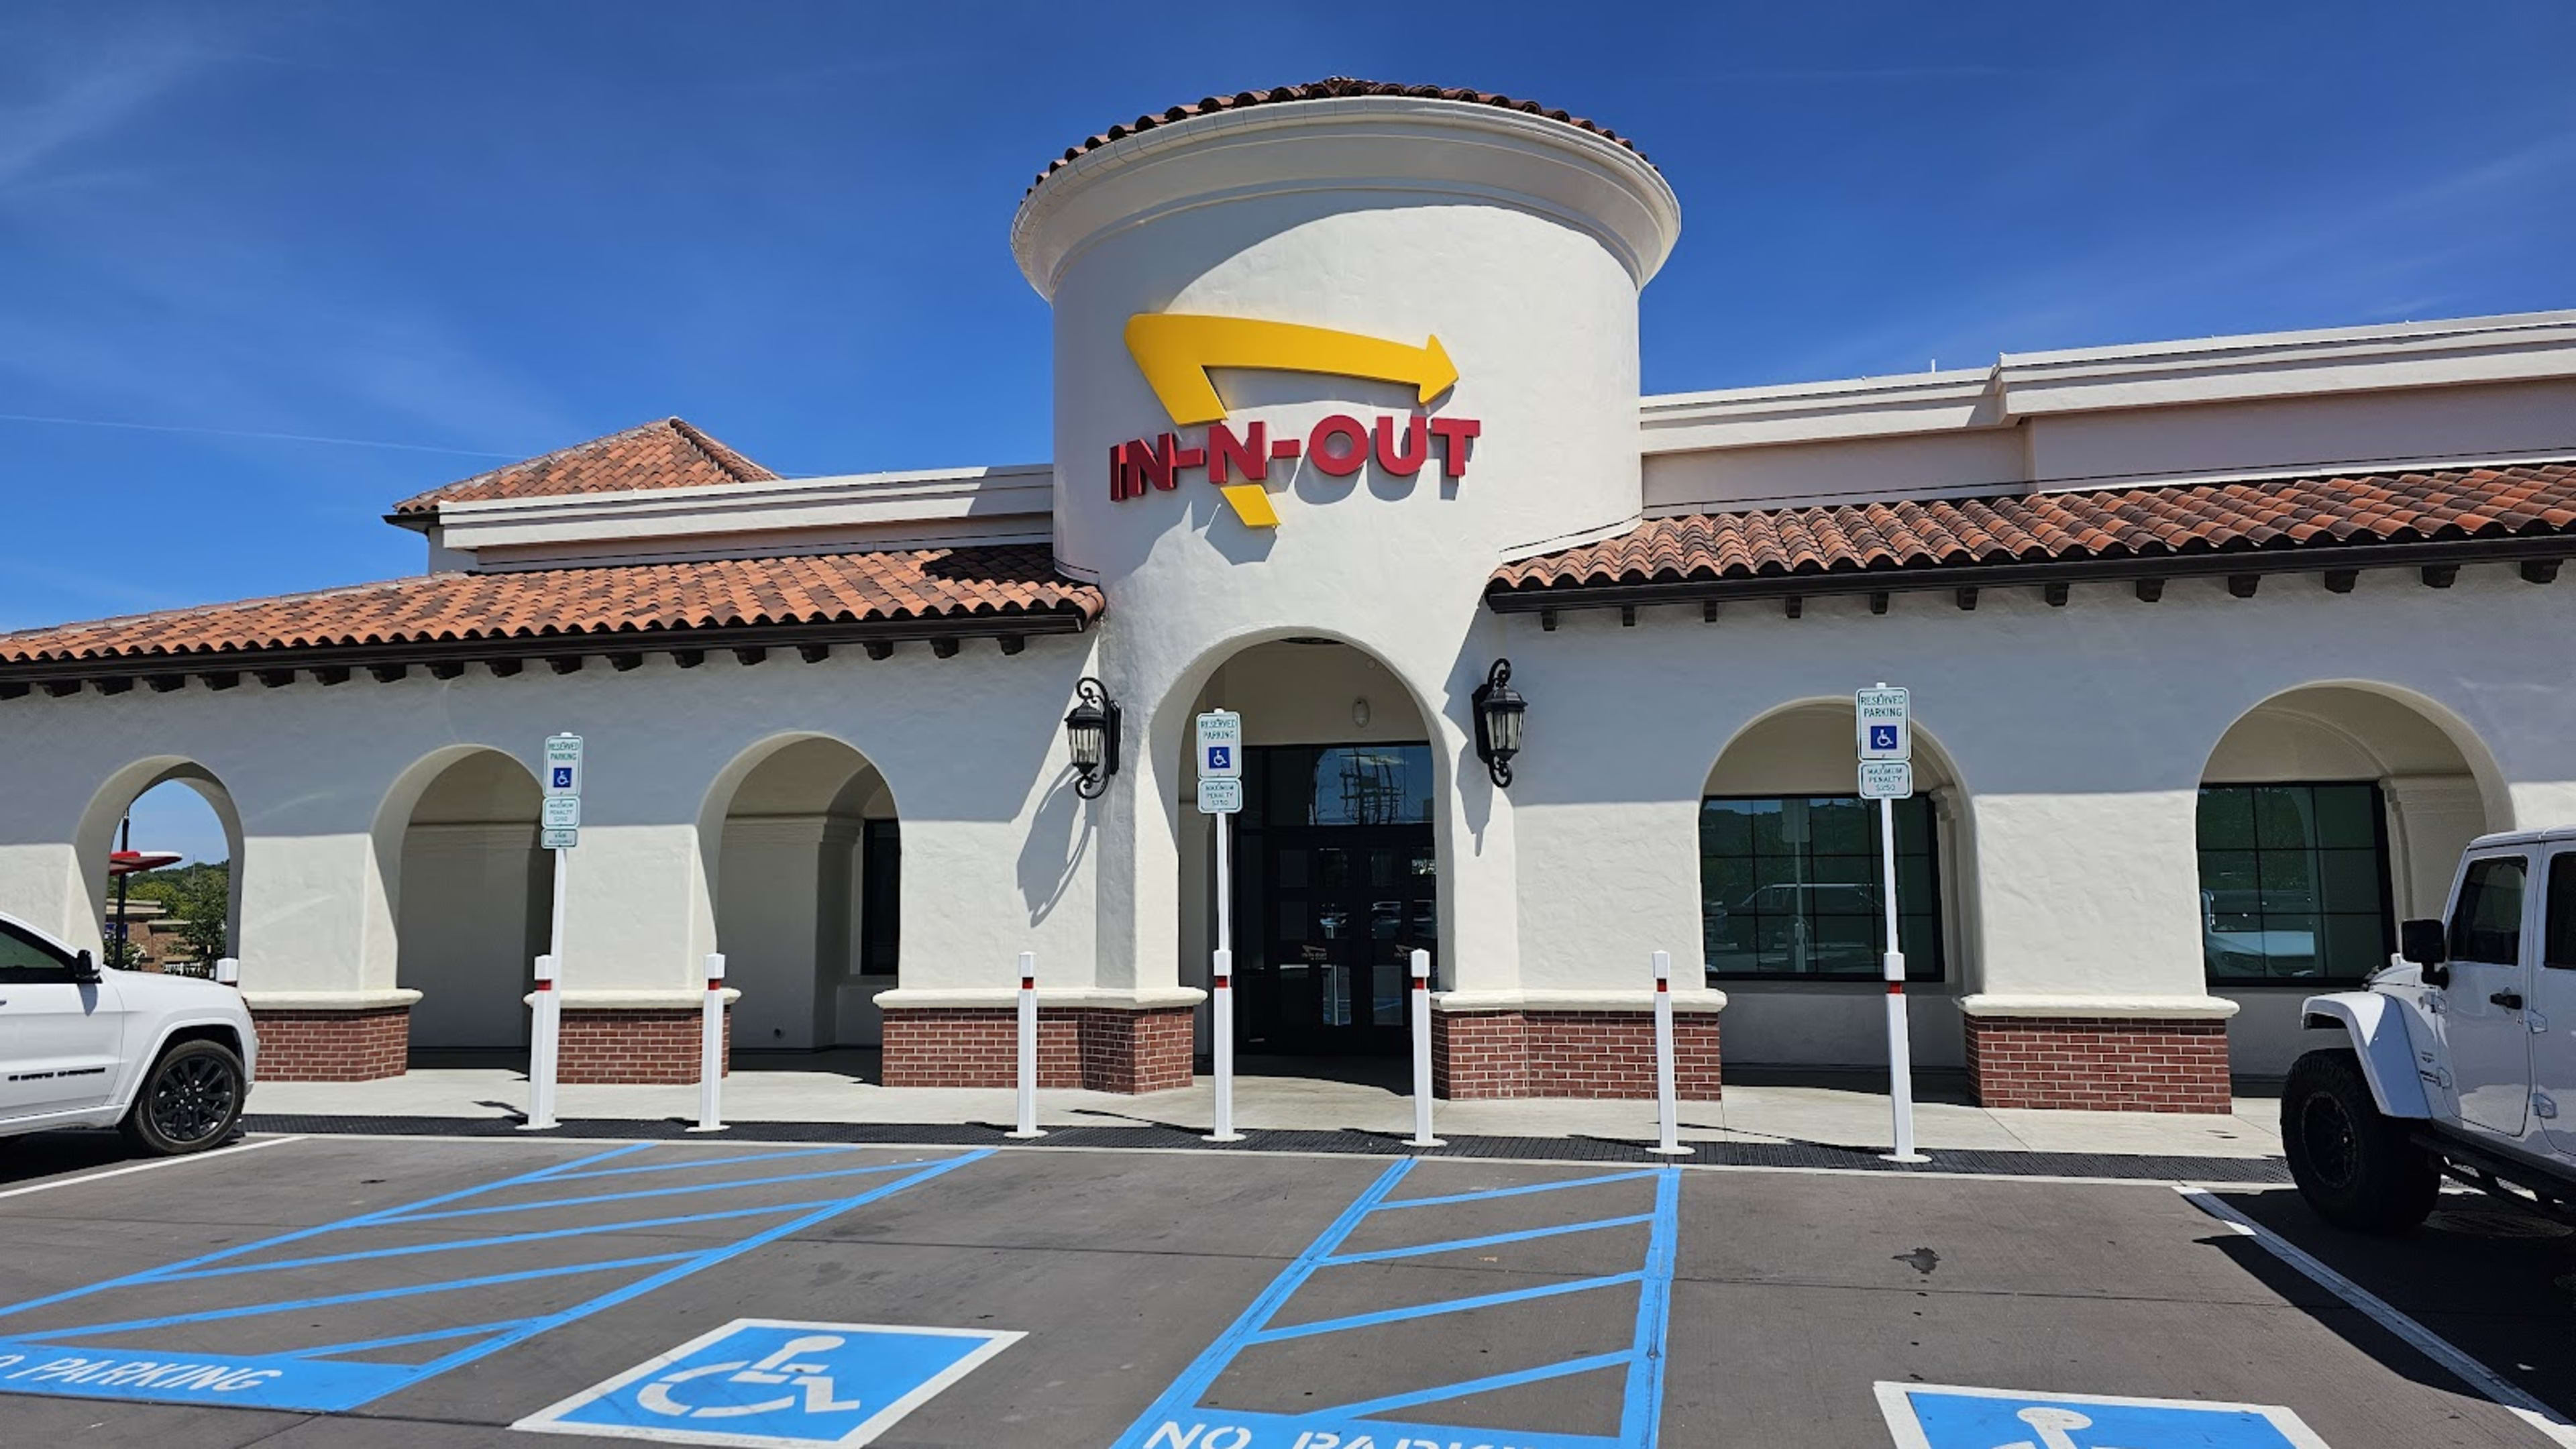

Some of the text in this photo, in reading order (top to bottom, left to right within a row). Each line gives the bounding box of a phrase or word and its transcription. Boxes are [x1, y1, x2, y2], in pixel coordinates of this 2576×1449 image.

[1110, 415, 1481, 502] IN-N-OUT
[1861, 695, 1905, 705] RESERVED
[1864, 708, 1902, 717] PARKING
[1201, 719, 1238, 729] RESERVED
[5, 1358, 282, 1391] PARKING
[1142, 1421, 1252, 1449] NO
